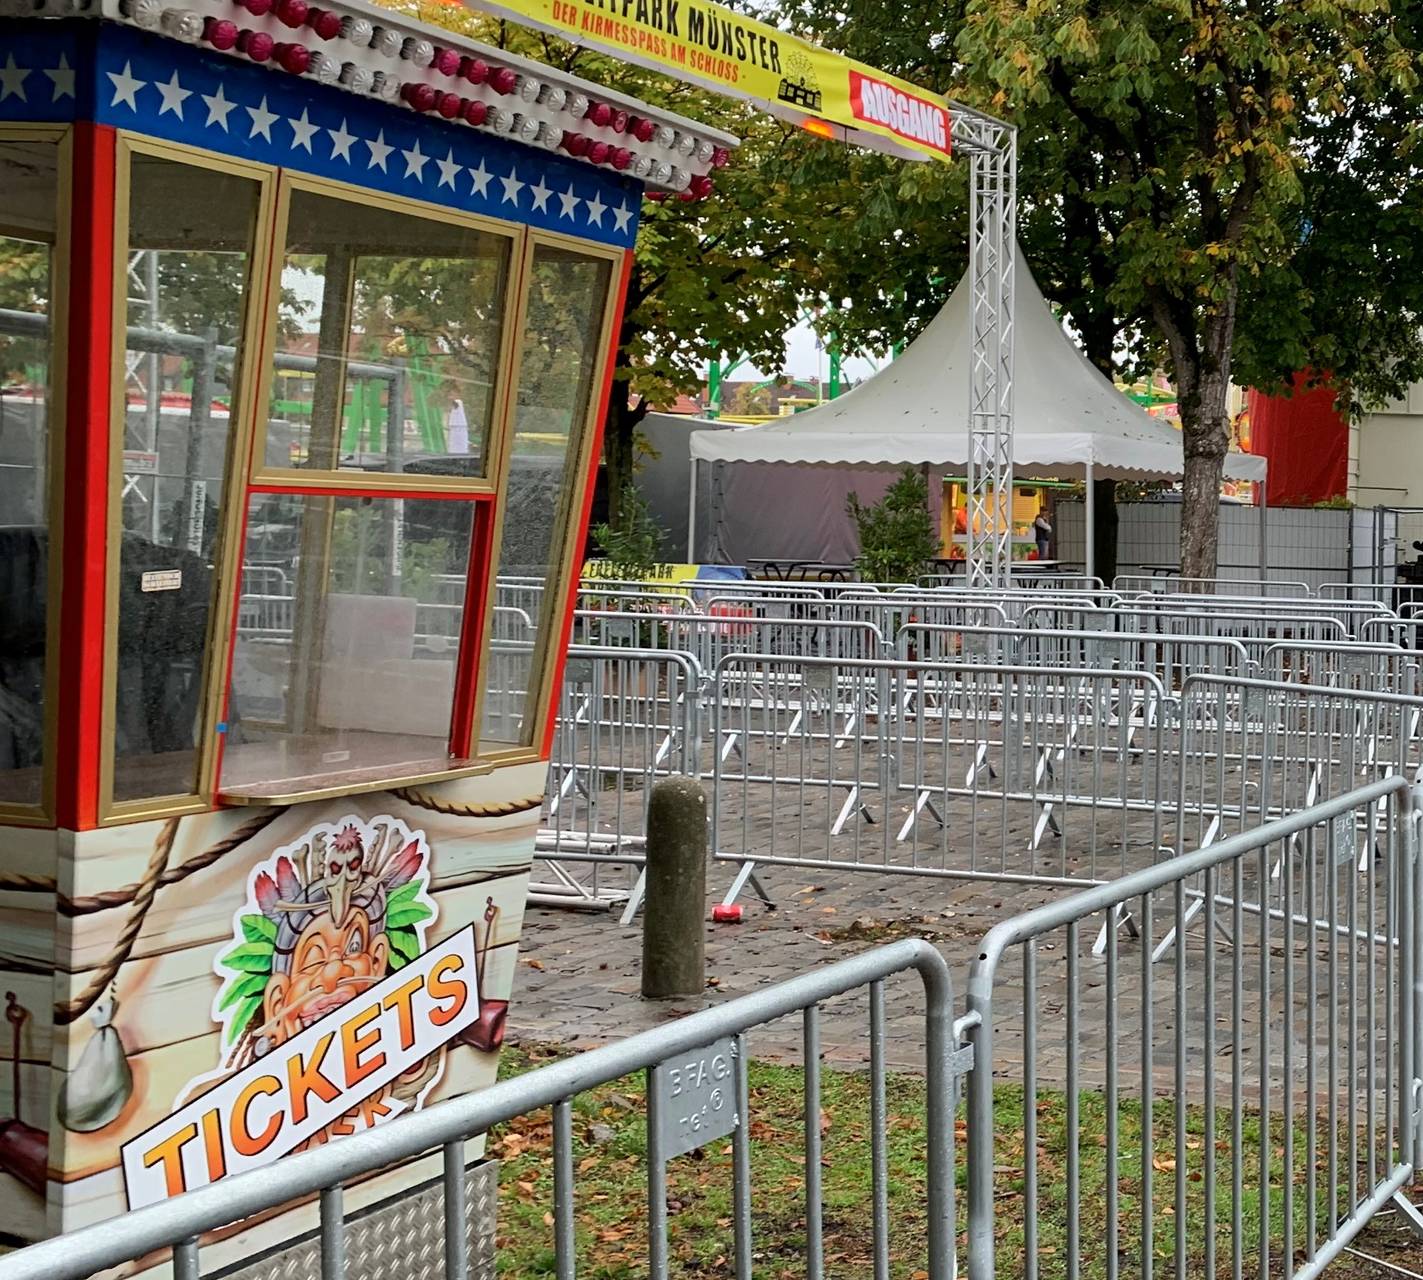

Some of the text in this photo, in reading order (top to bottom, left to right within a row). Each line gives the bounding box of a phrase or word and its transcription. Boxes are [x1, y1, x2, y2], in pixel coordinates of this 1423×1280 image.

[552, 0, 739, 83] DER KIRMESSPASS AM SCHLOSS
[688, 6, 781, 75] MÜNSTER
[861, 79, 946, 149] AUSGANG
[143, 954, 467, 1198] TICKETS
